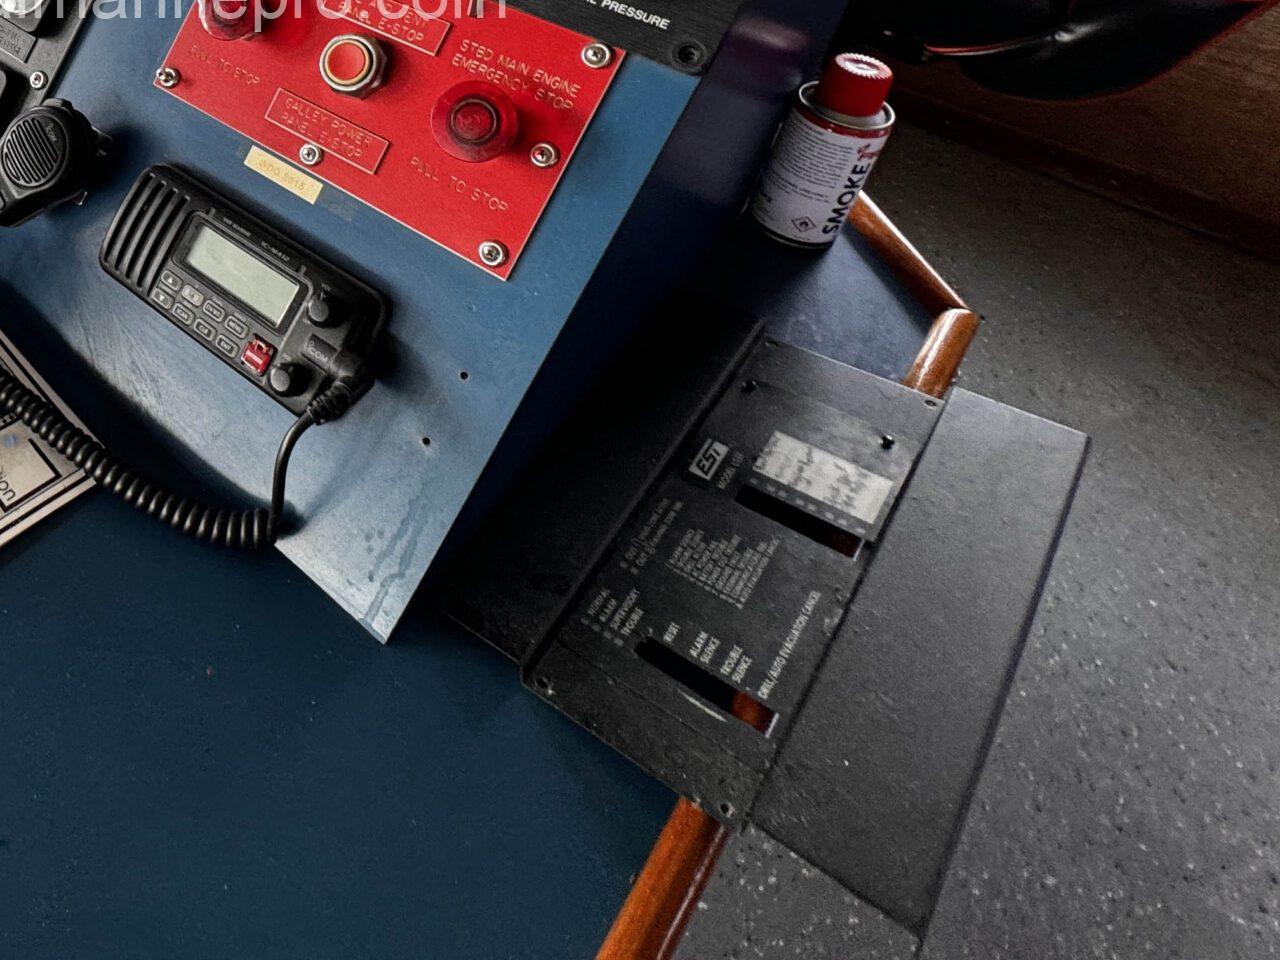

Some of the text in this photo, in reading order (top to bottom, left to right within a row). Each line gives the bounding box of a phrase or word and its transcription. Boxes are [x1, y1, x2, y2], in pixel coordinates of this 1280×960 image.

[378, 18, 424, 41] E-STOP
[452, 53, 573, 109] EMERGENCY STOP
[460, 39, 581, 98] STBD MAIN ENGINE
[285, 98, 372, 147] GALLEY POWER
[448, 175, 466, 193] TO
[471, 188, 508, 211] STOP
[822, 164, 870, 235] SMOKE
[220, 341, 231, 351] ENT
[621, 608, 642, 635] TROUBLE
[662, 623, 680, 642] RESET
[780, 615, 807, 656] EVACUATION
[802, 590, 820, 614] CANCEL
[689, 631, 708, 656] ALARM
[700, 637, 719, 662] SILENCE
[721, 645, 742, 674] TROUBLE
[732, 656, 751, 681] SILENCE
